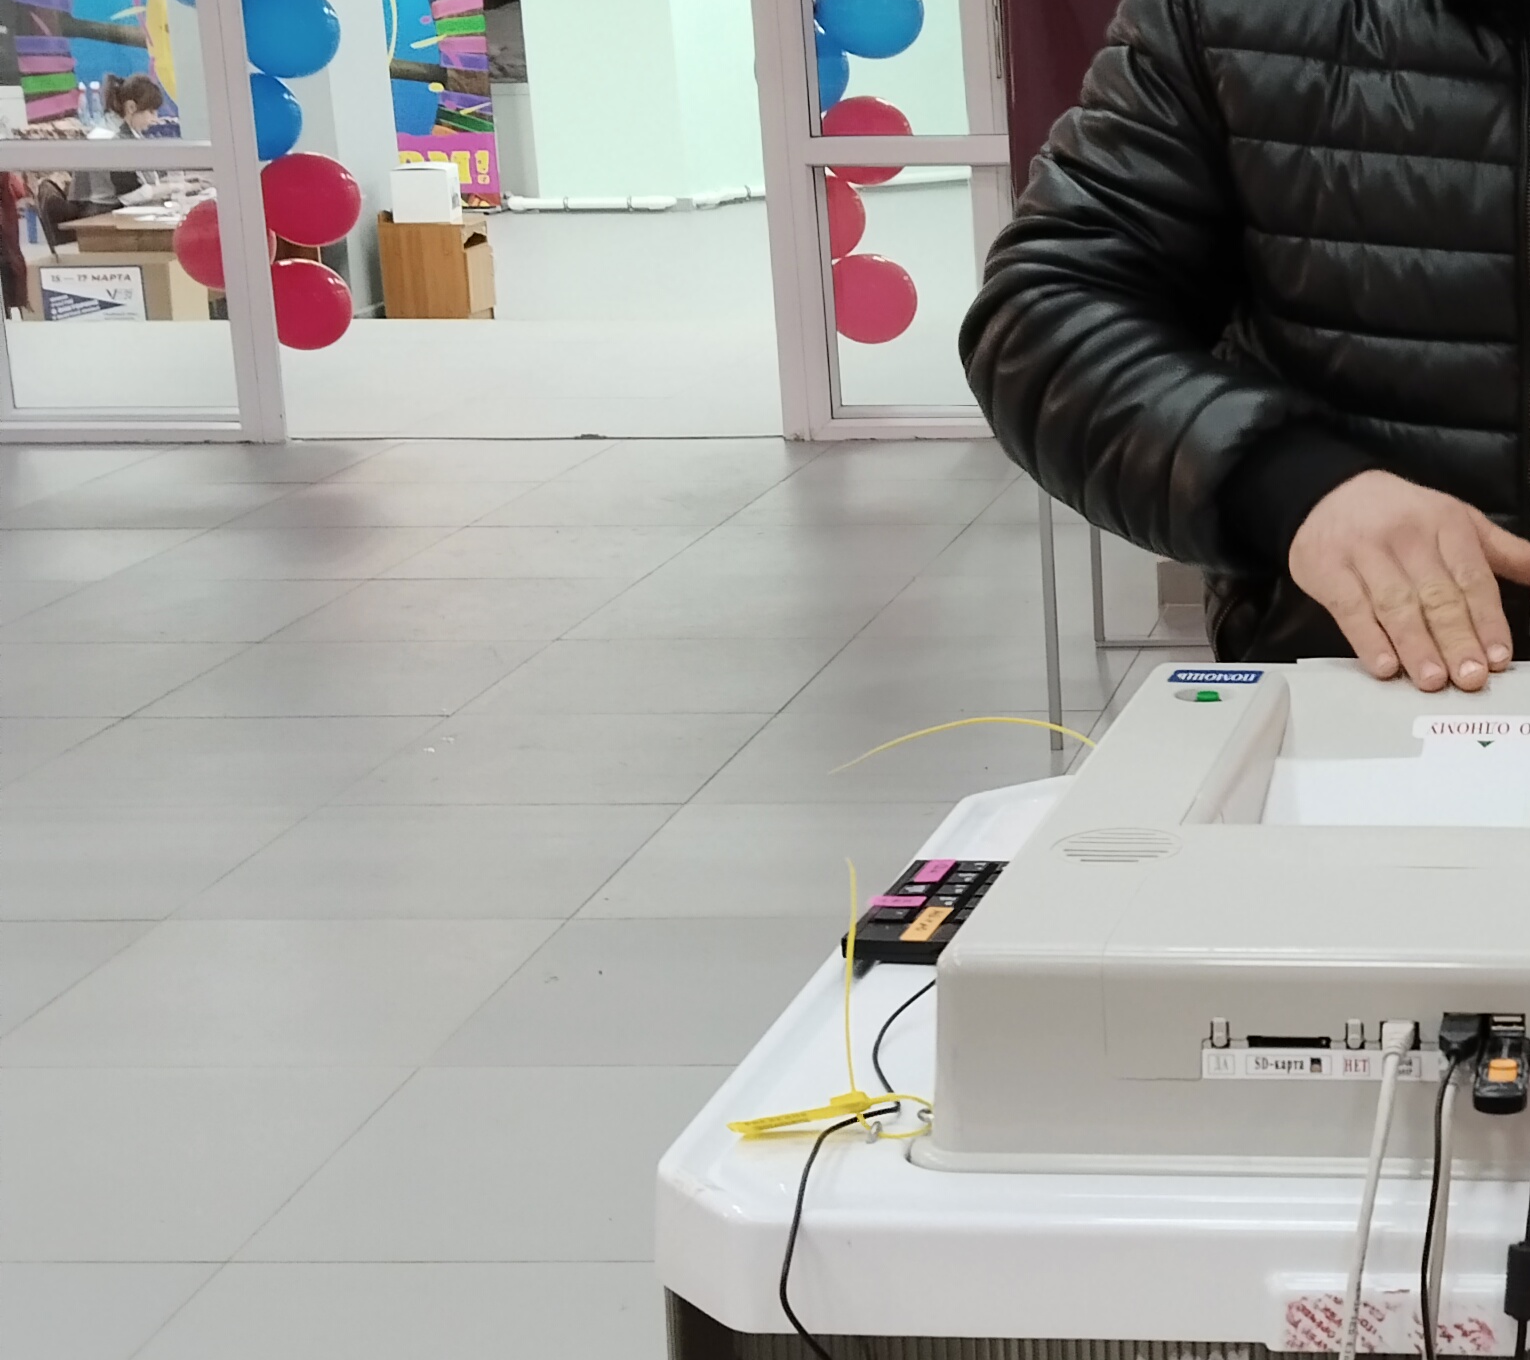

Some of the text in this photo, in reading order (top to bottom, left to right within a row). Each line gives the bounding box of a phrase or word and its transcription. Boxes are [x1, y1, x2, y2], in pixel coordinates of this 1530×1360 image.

[91, 273, 132, 282] МАРТА
[1428, 721, 1511, 736] ОДНОМУ
[1254, 1058, 1305, 1073] SD-карта
[1344, 1058, 1369, 1073] НЕТ
